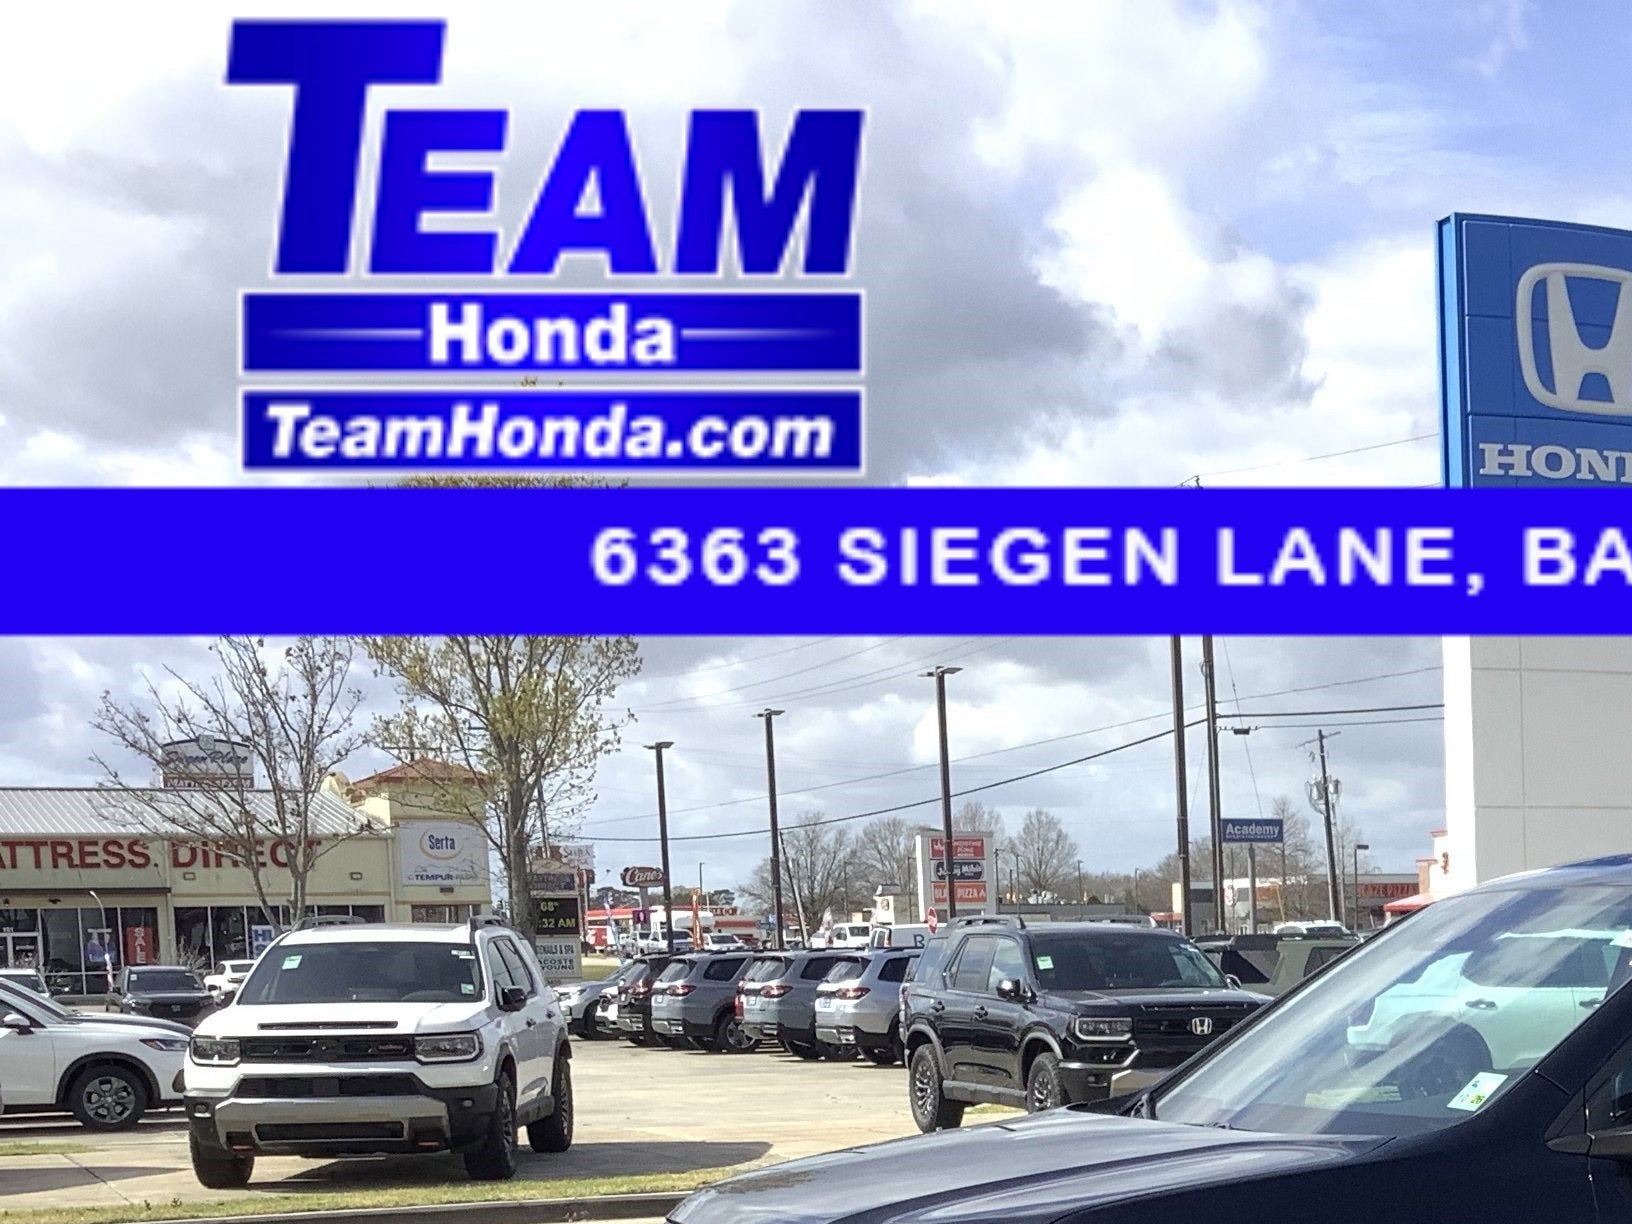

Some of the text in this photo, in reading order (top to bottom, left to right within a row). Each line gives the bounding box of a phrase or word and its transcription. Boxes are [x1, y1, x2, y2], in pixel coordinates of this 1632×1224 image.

[1225, 823, 1280, 838] Academy
[428, 834, 456, 851] Serta
[557, 918, 576, 928] AM
[134, 927, 147, 964] SALE
